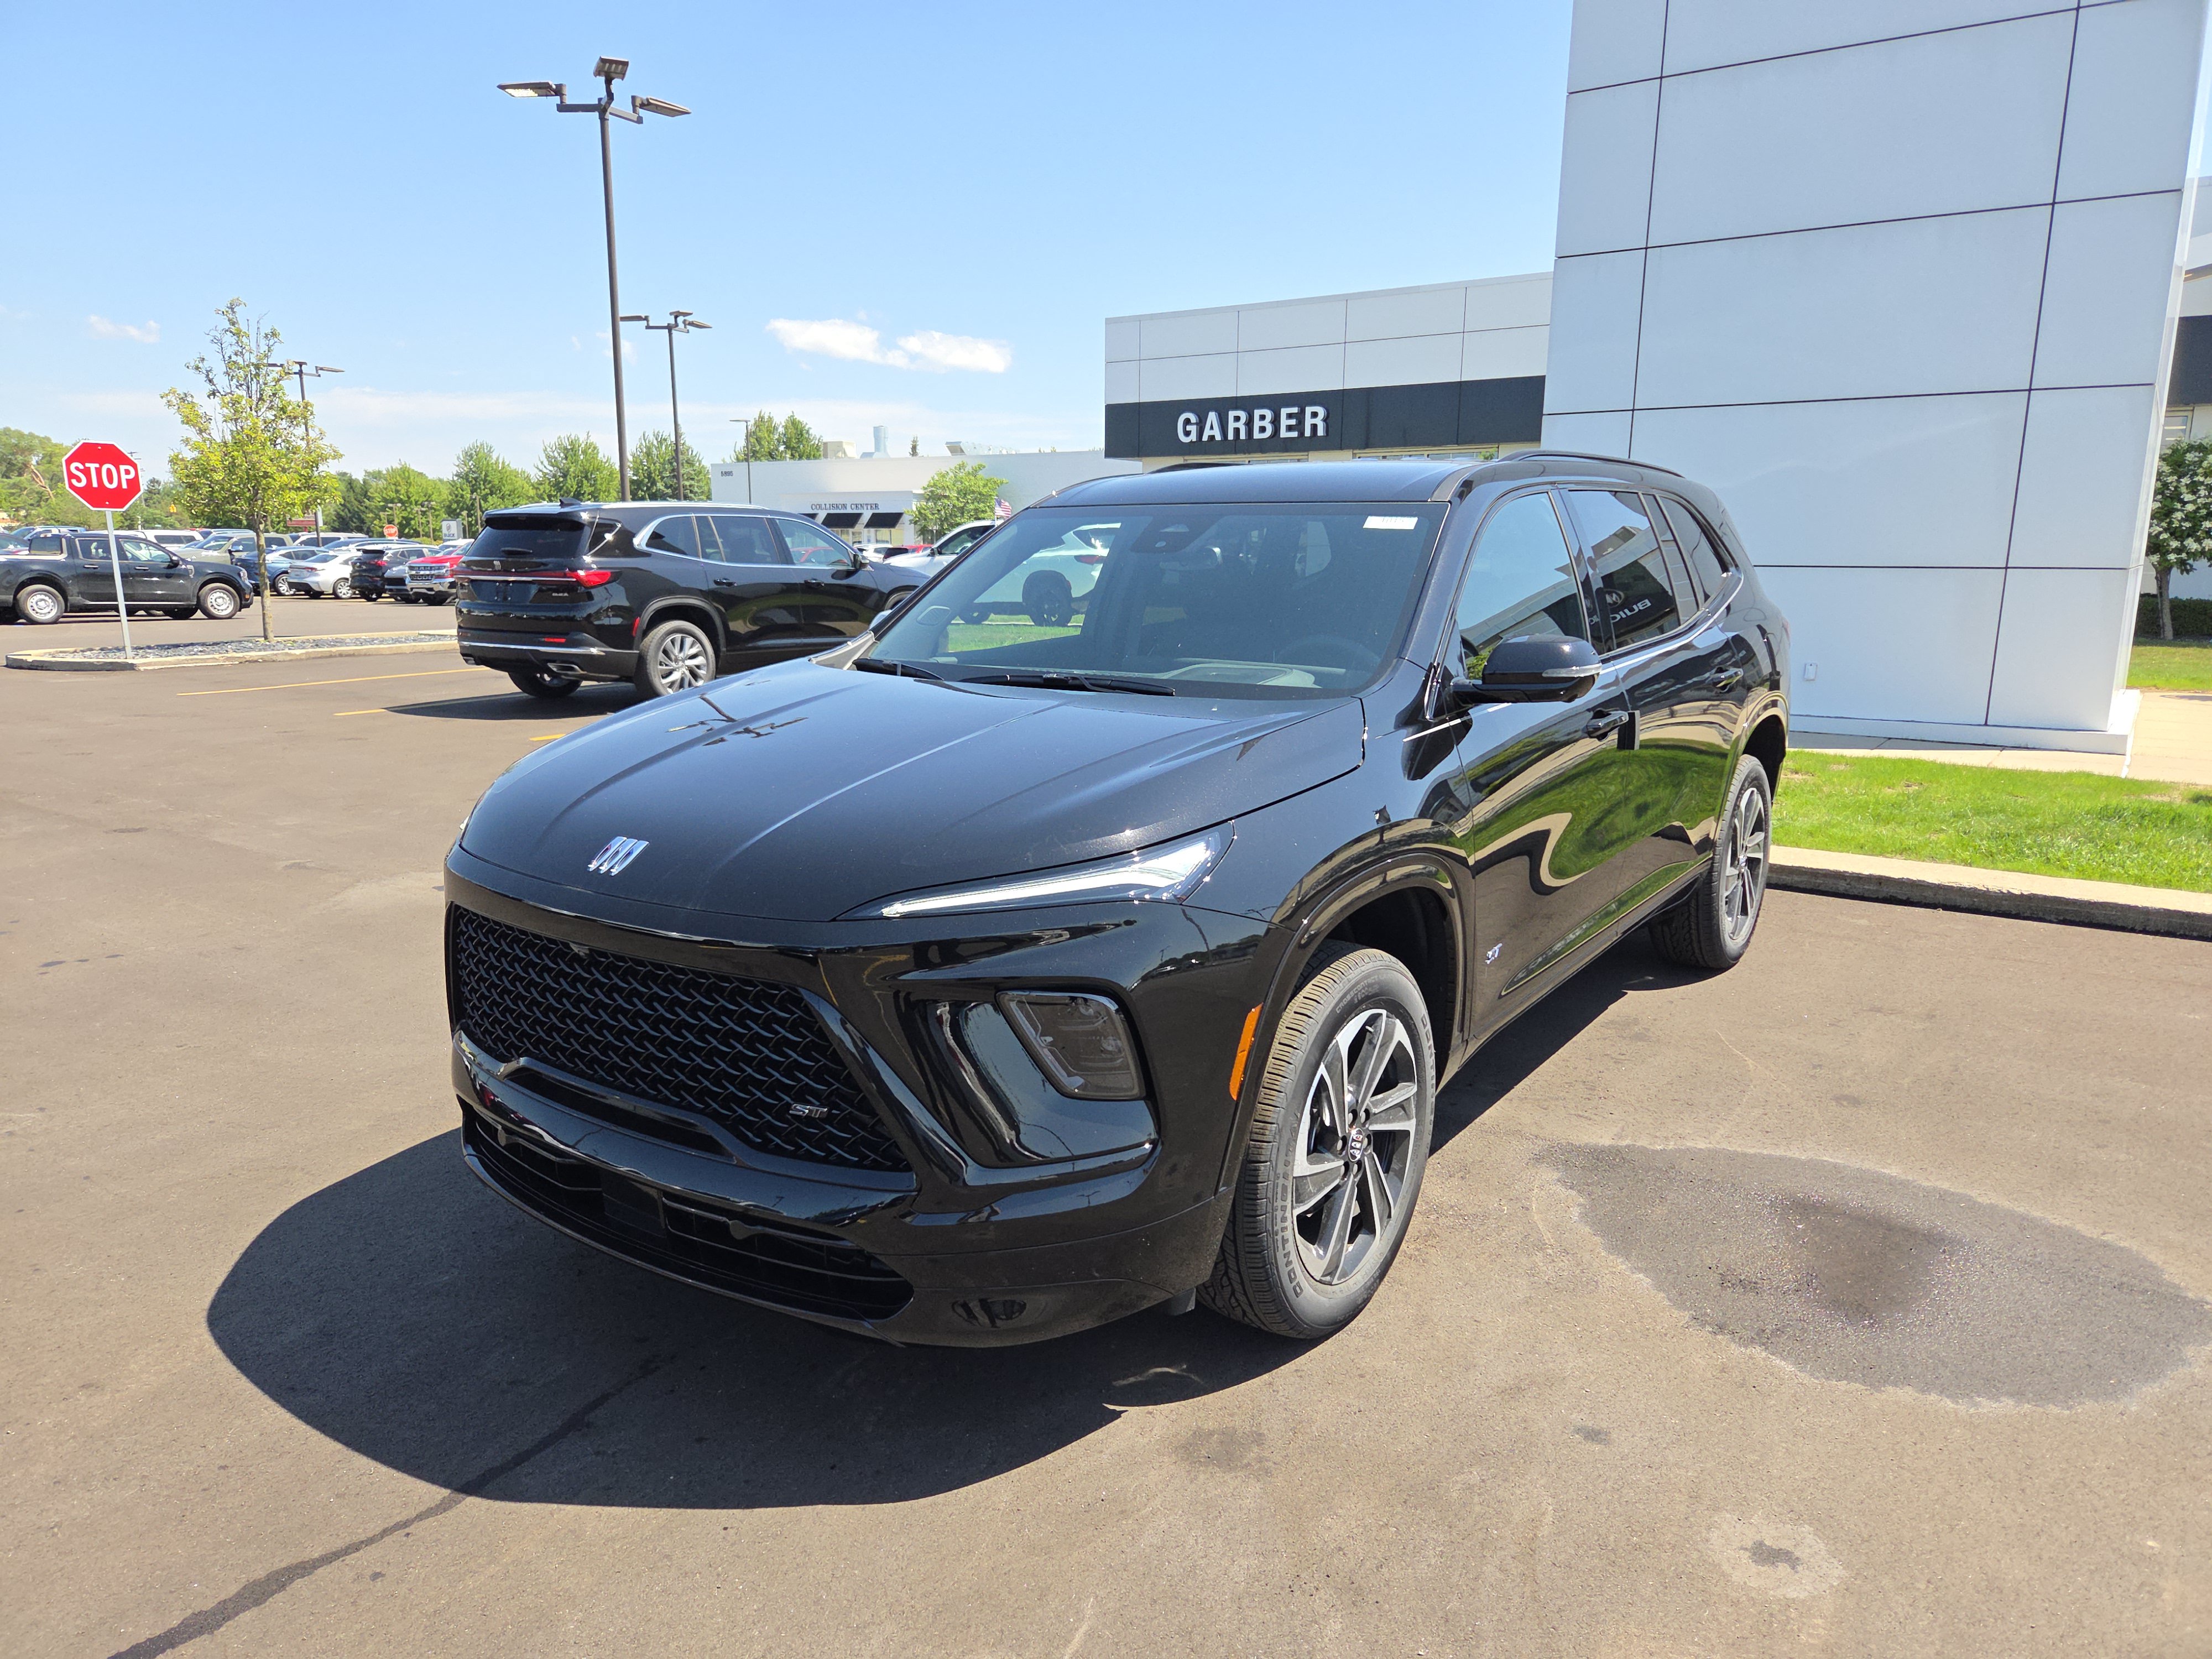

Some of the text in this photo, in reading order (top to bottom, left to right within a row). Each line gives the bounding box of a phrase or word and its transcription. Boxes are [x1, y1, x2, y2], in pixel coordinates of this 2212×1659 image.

[1177, 406, 1327, 443] GARBER
[70, 462, 135, 489] STOP
[789, 1103, 828, 1118] ST
